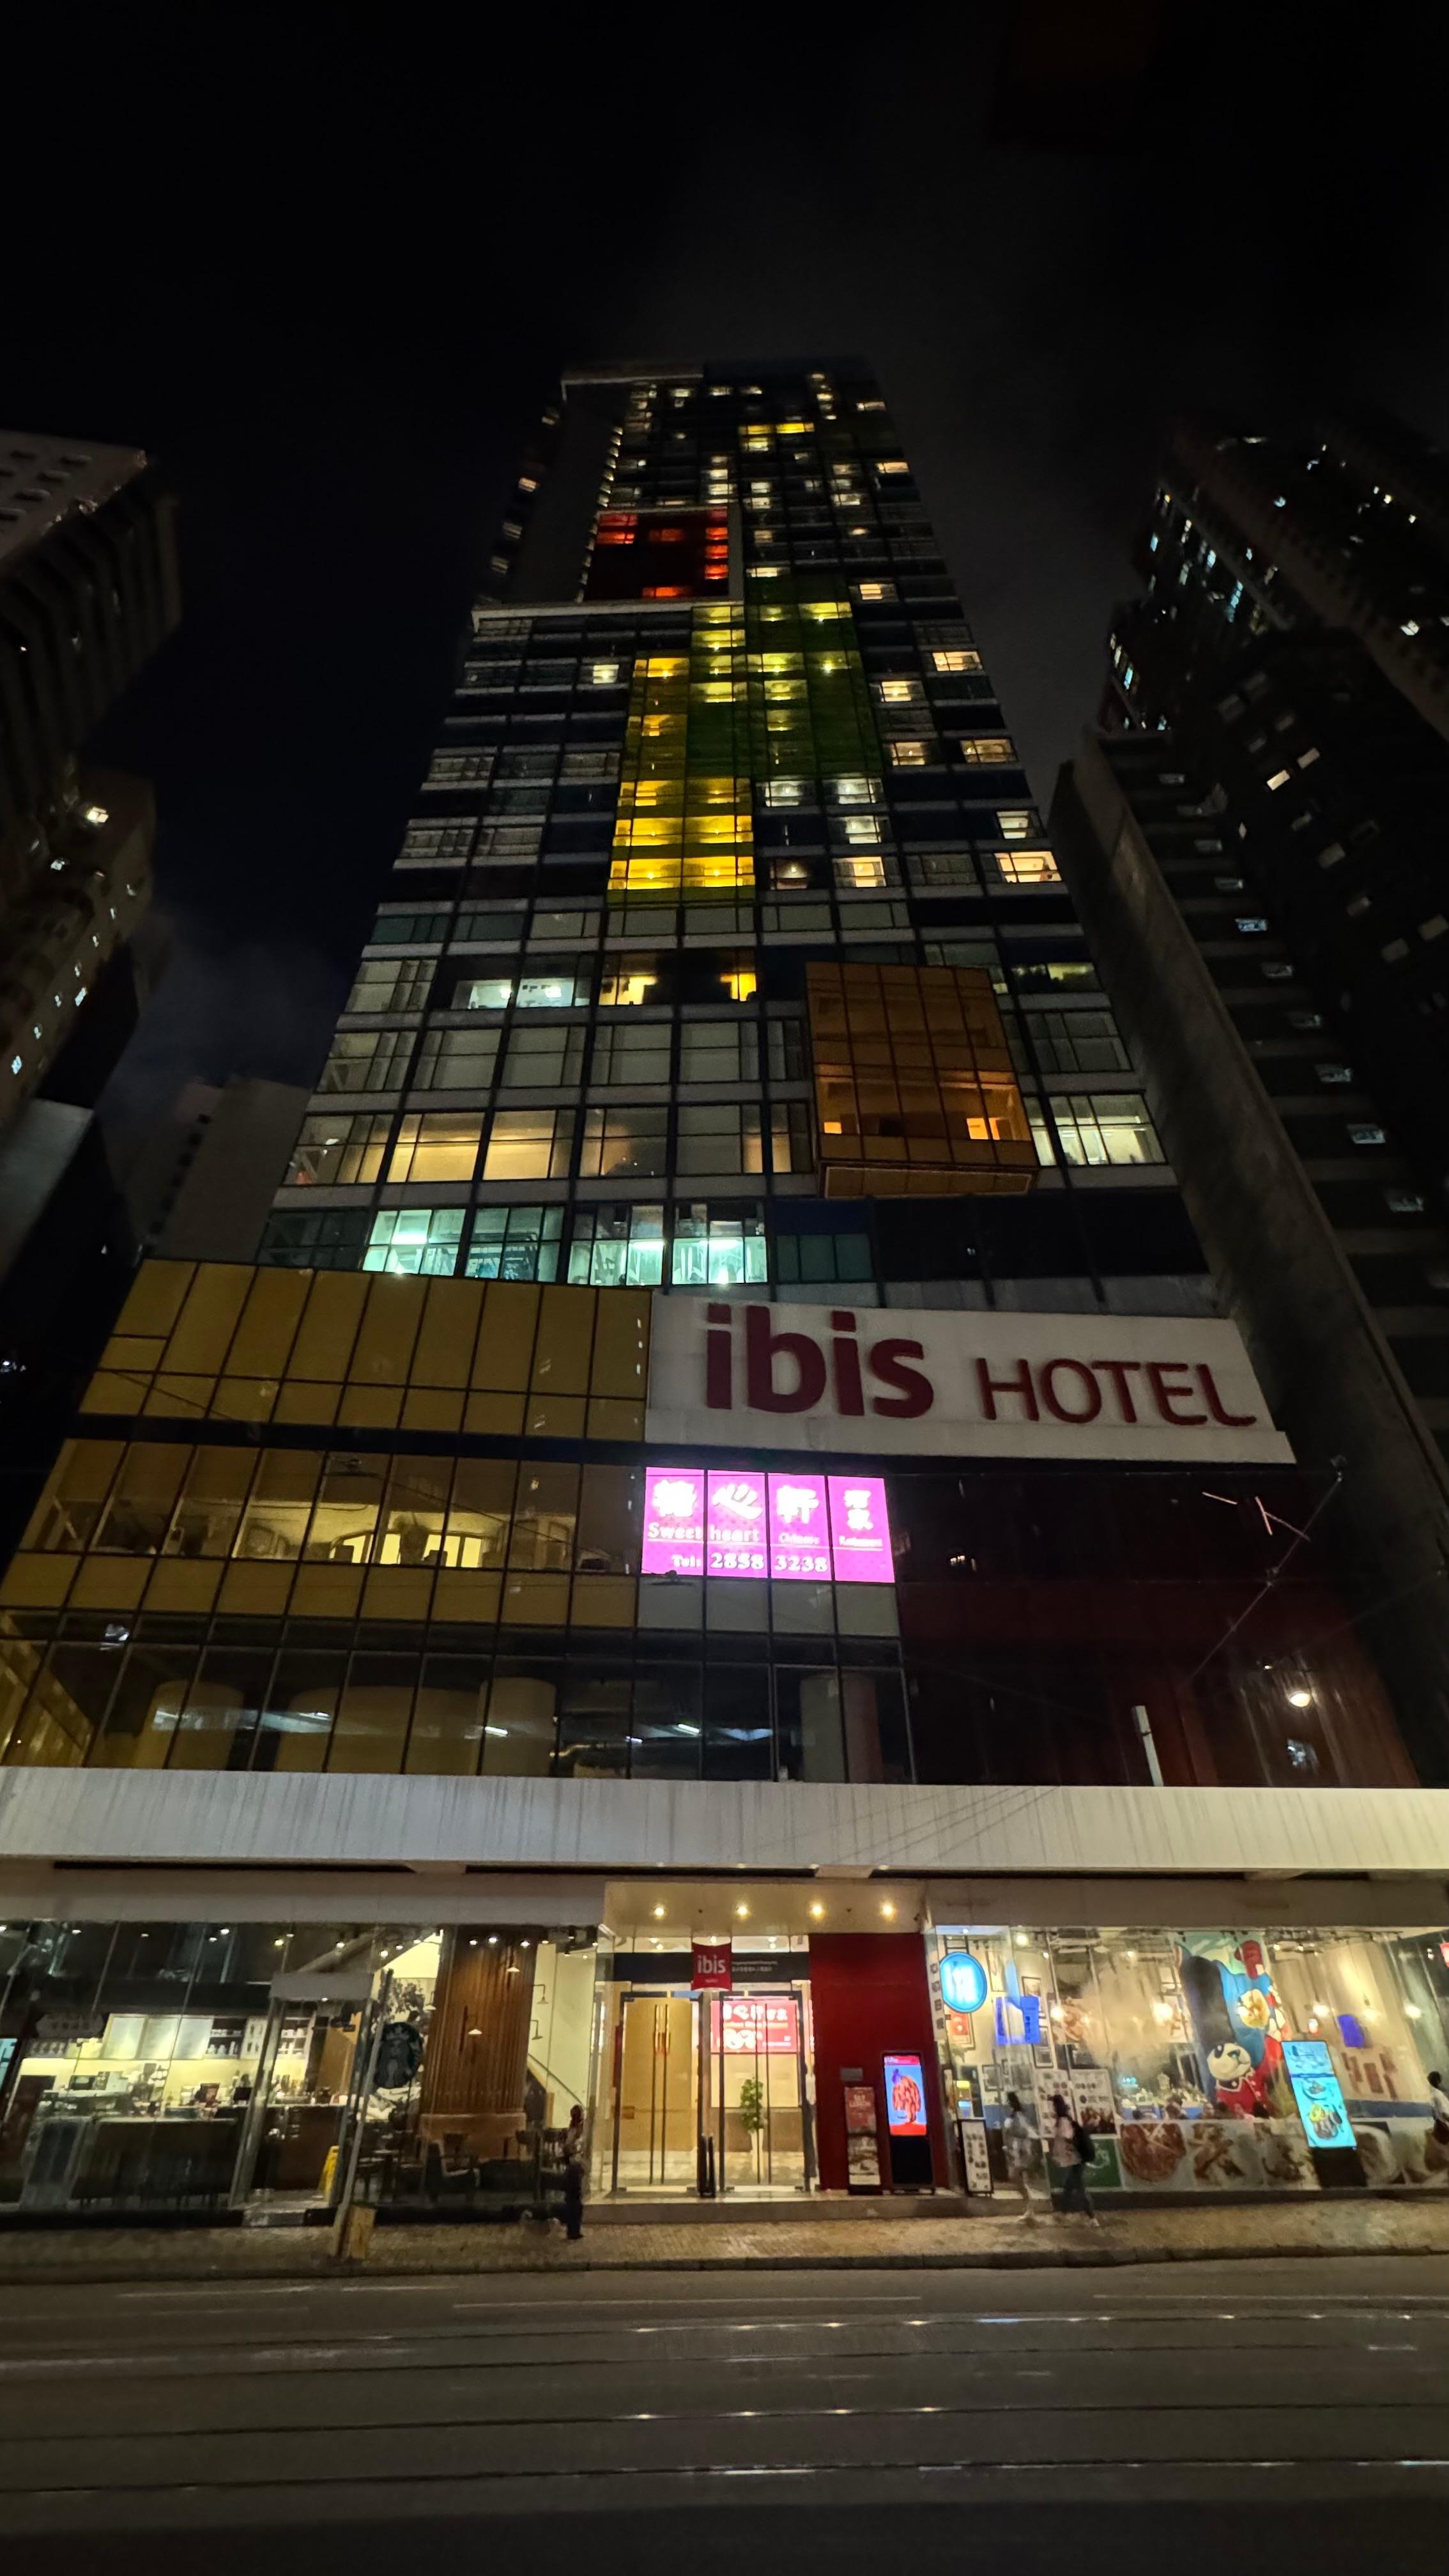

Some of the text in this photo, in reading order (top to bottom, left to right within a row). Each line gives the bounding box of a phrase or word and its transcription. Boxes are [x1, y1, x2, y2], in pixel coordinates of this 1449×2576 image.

[707, 1303, 1258, 1427] ibis HOTEL
[774, 1554, 829, 1573] 3238
[697, 1954, 726, 1974] ibis
